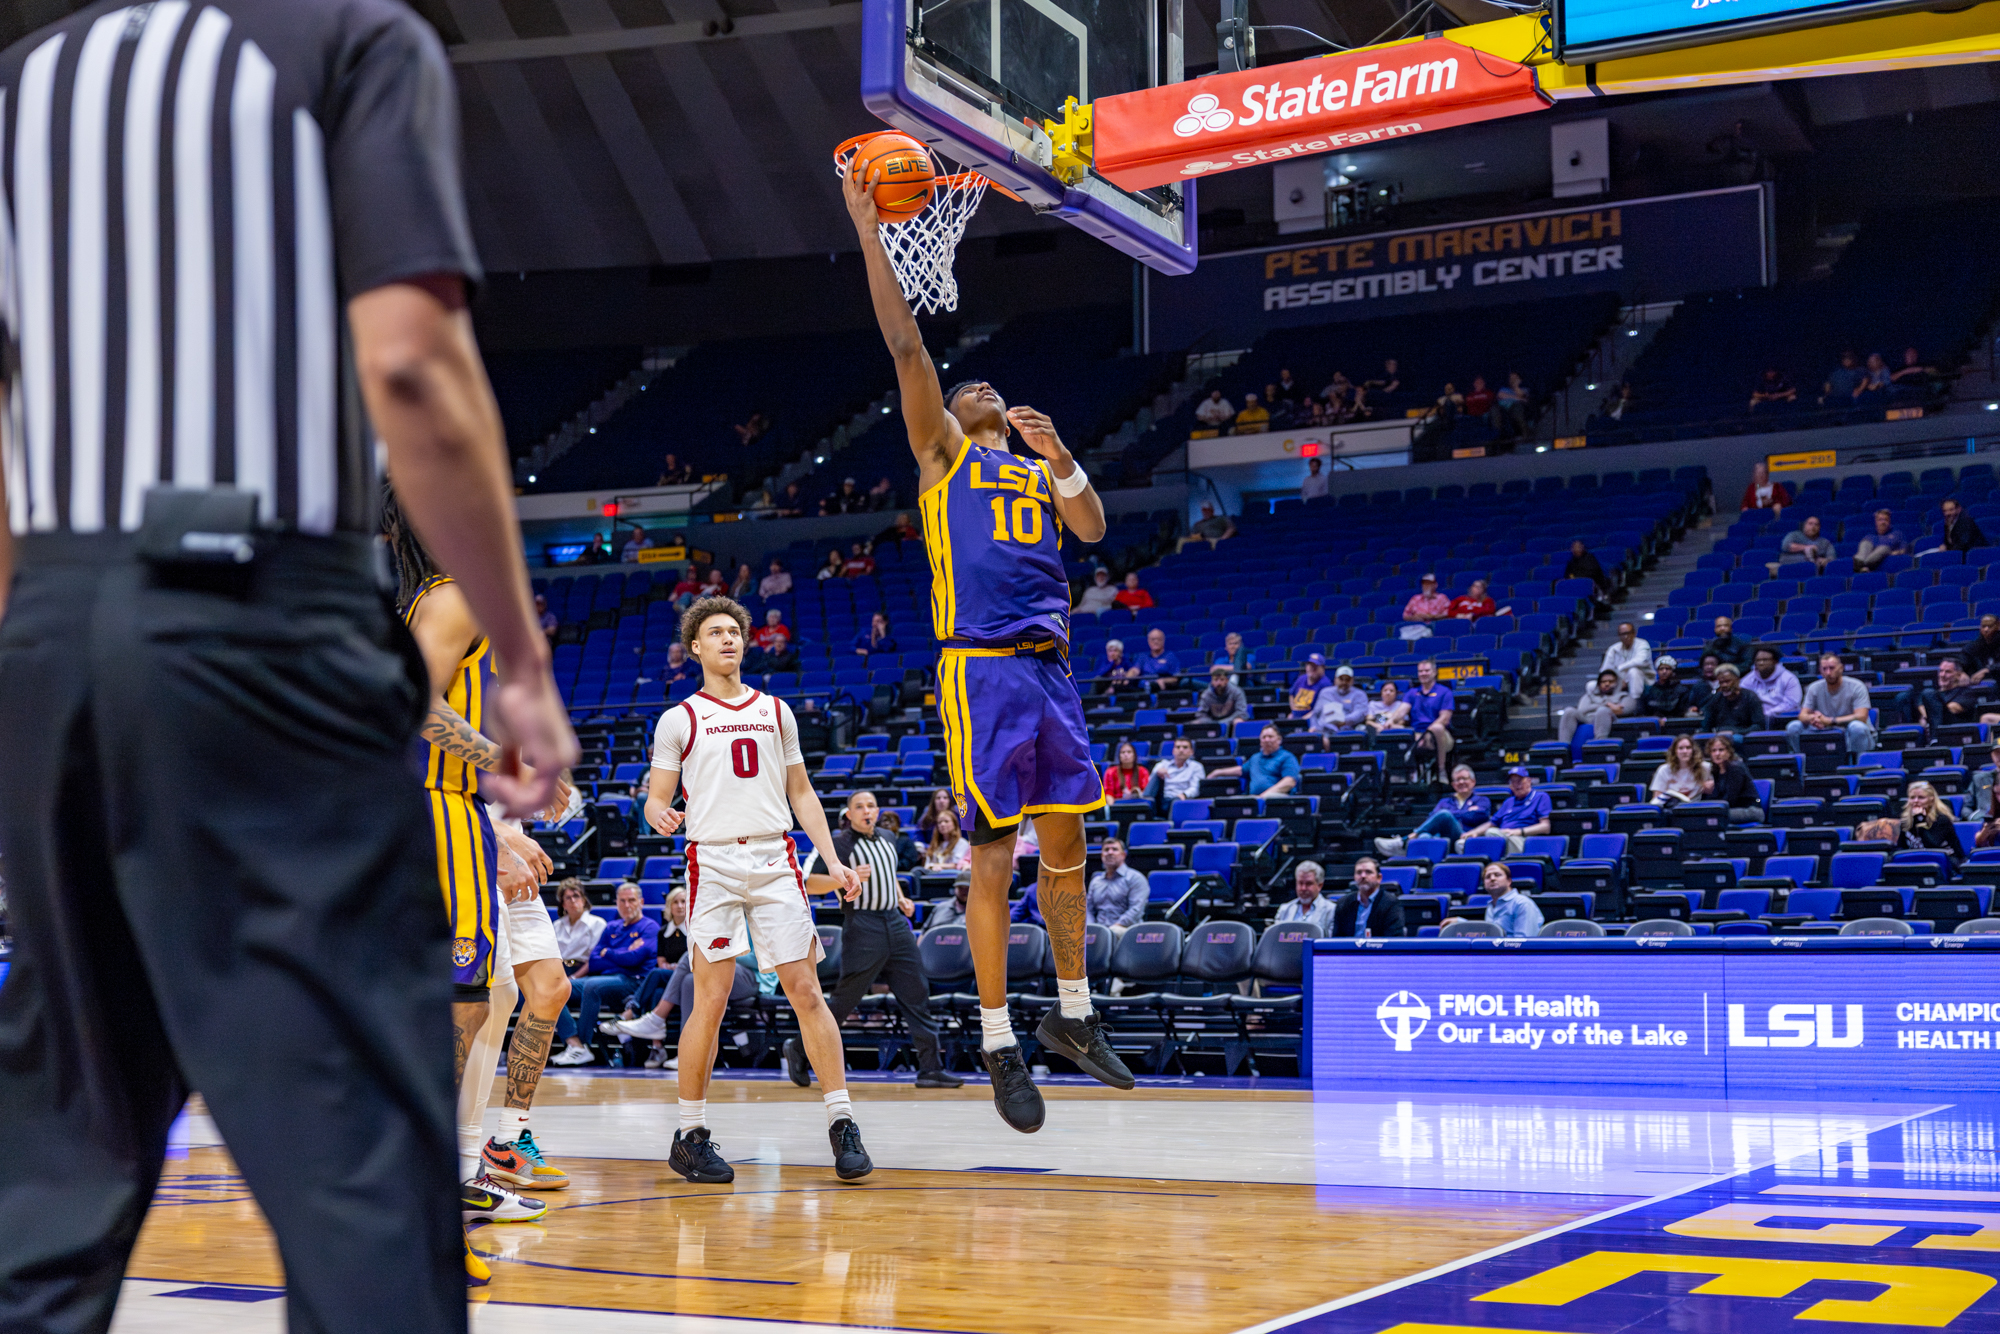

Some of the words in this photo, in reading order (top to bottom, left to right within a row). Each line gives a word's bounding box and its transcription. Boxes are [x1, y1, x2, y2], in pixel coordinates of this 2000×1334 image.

[1238, 73, 1348, 126] State
[1350, 57, 1458, 108] Farm
[1232, 137, 1328, 164] State
[1329, 122, 1422, 148] Farm
[886, 160, 929, 176] ELITE
[1265, 240, 1375, 280] PETE
[1387, 208, 1622, 265] MARAVICH
[1264, 264, 1462, 312] ASSEMBLY
[1473, 244, 1624, 287] CENTER
[991, 496, 1042, 544] 10
[1016, 641, 1035, 650] LSU
[1451, 666, 1480, 678] 104
[705, 723, 775, 735] RAZORBACKS
[731, 737, 759, 778] 0
[1136, 933, 1165, 943] LSU
[1207, 933, 1236, 944] LSU
[1438, 994, 1508, 1016] FMOL
[1514, 994, 1600, 1017] Health
[1437, 1022, 1483, 1043] Our
[1489, 1022, 1546, 1050] Lady
[1551, 1022, 1578, 1044] of
[1583, 1022, 1624, 1045] the
[1631, 1023, 1688, 1046] Lake
[1728, 1003, 1864, 1048] LSU
[1897, 1030, 1990, 1049] HEALTH
